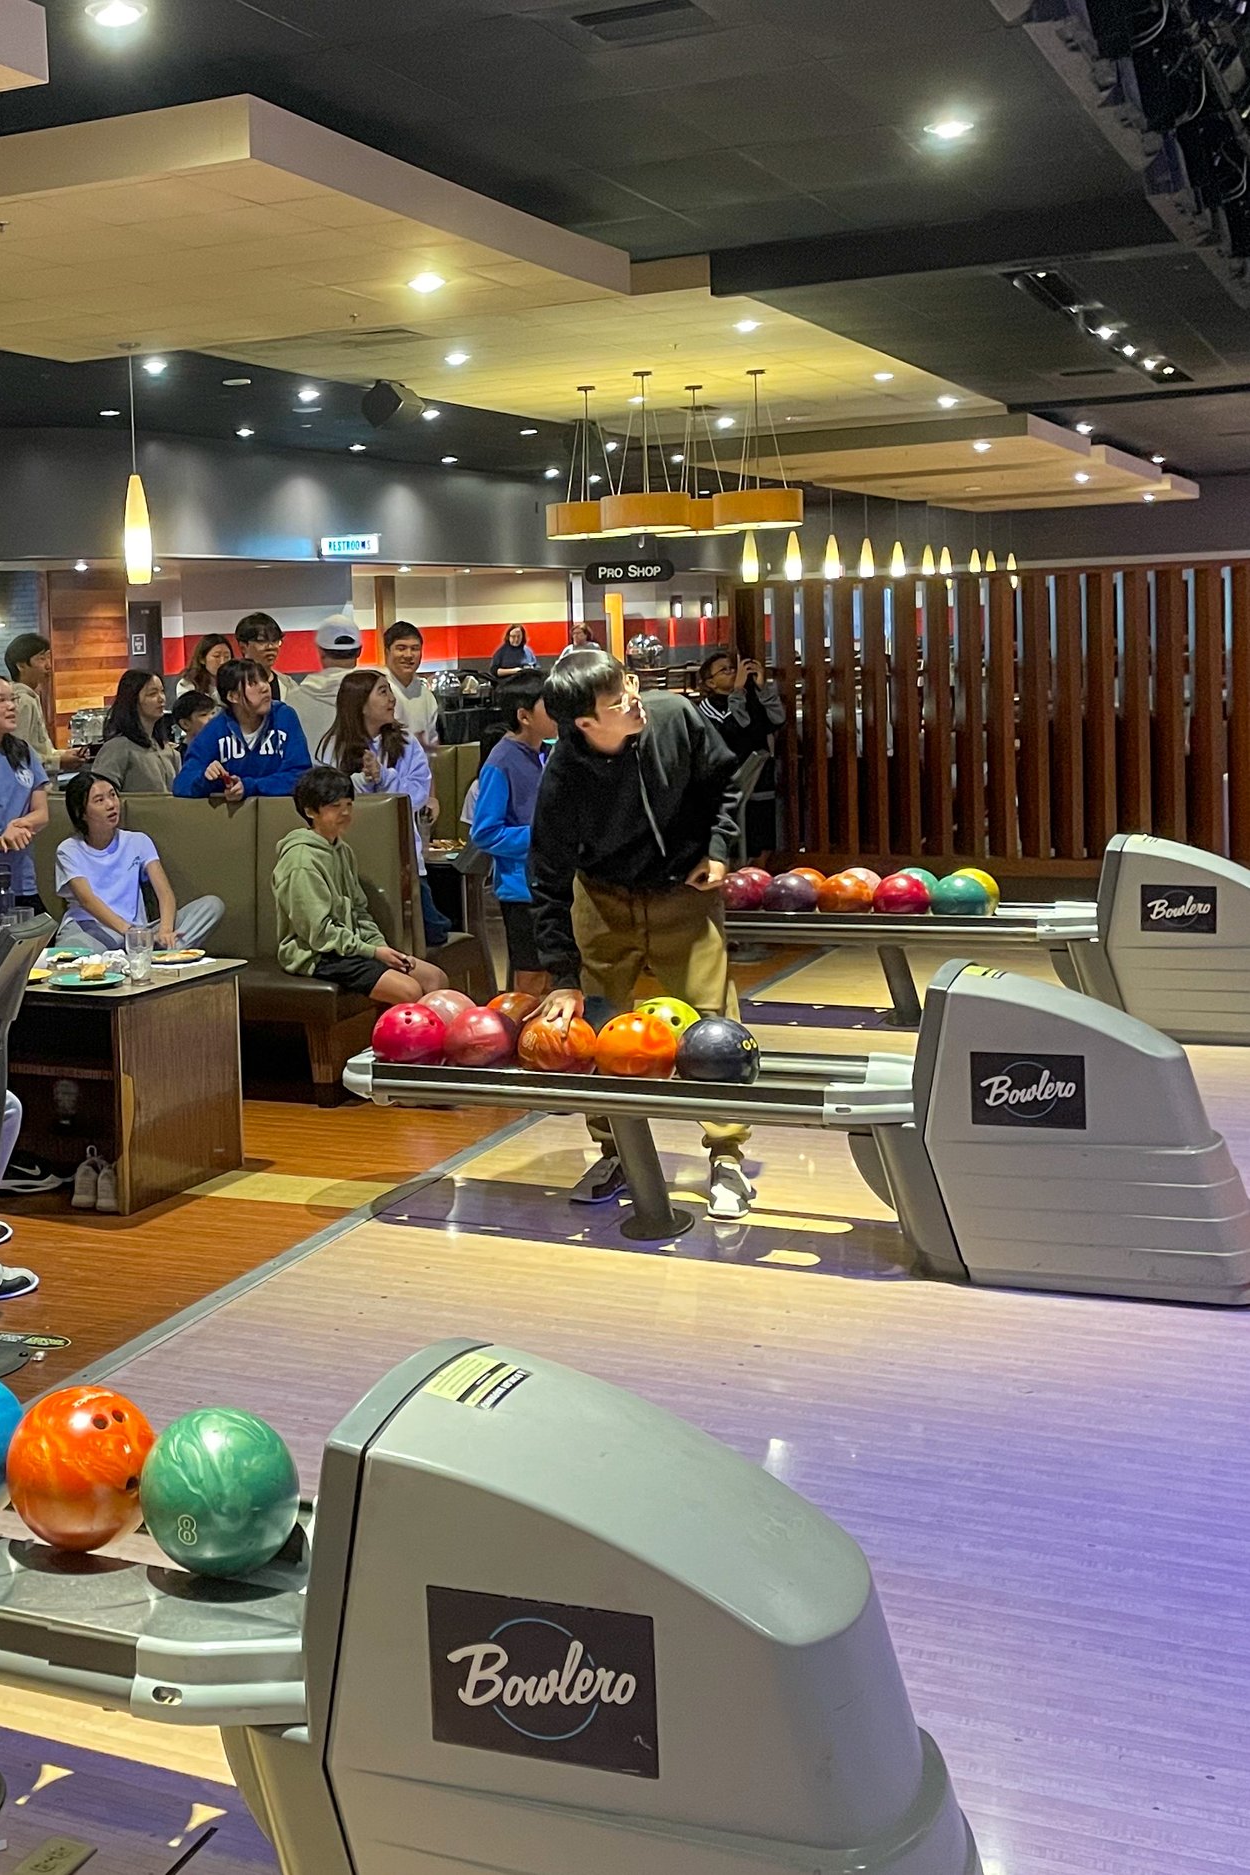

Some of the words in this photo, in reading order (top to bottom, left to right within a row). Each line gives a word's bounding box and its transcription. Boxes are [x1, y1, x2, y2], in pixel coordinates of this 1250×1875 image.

[328, 540, 371, 551] RESTROOMS
[1146, 895, 1211, 920] Bowlero
[980, 1069, 1076, 1106] Bowlero
[178, 1514, 198, 1546] 8
[447, 1640, 637, 1707] Bowlero
